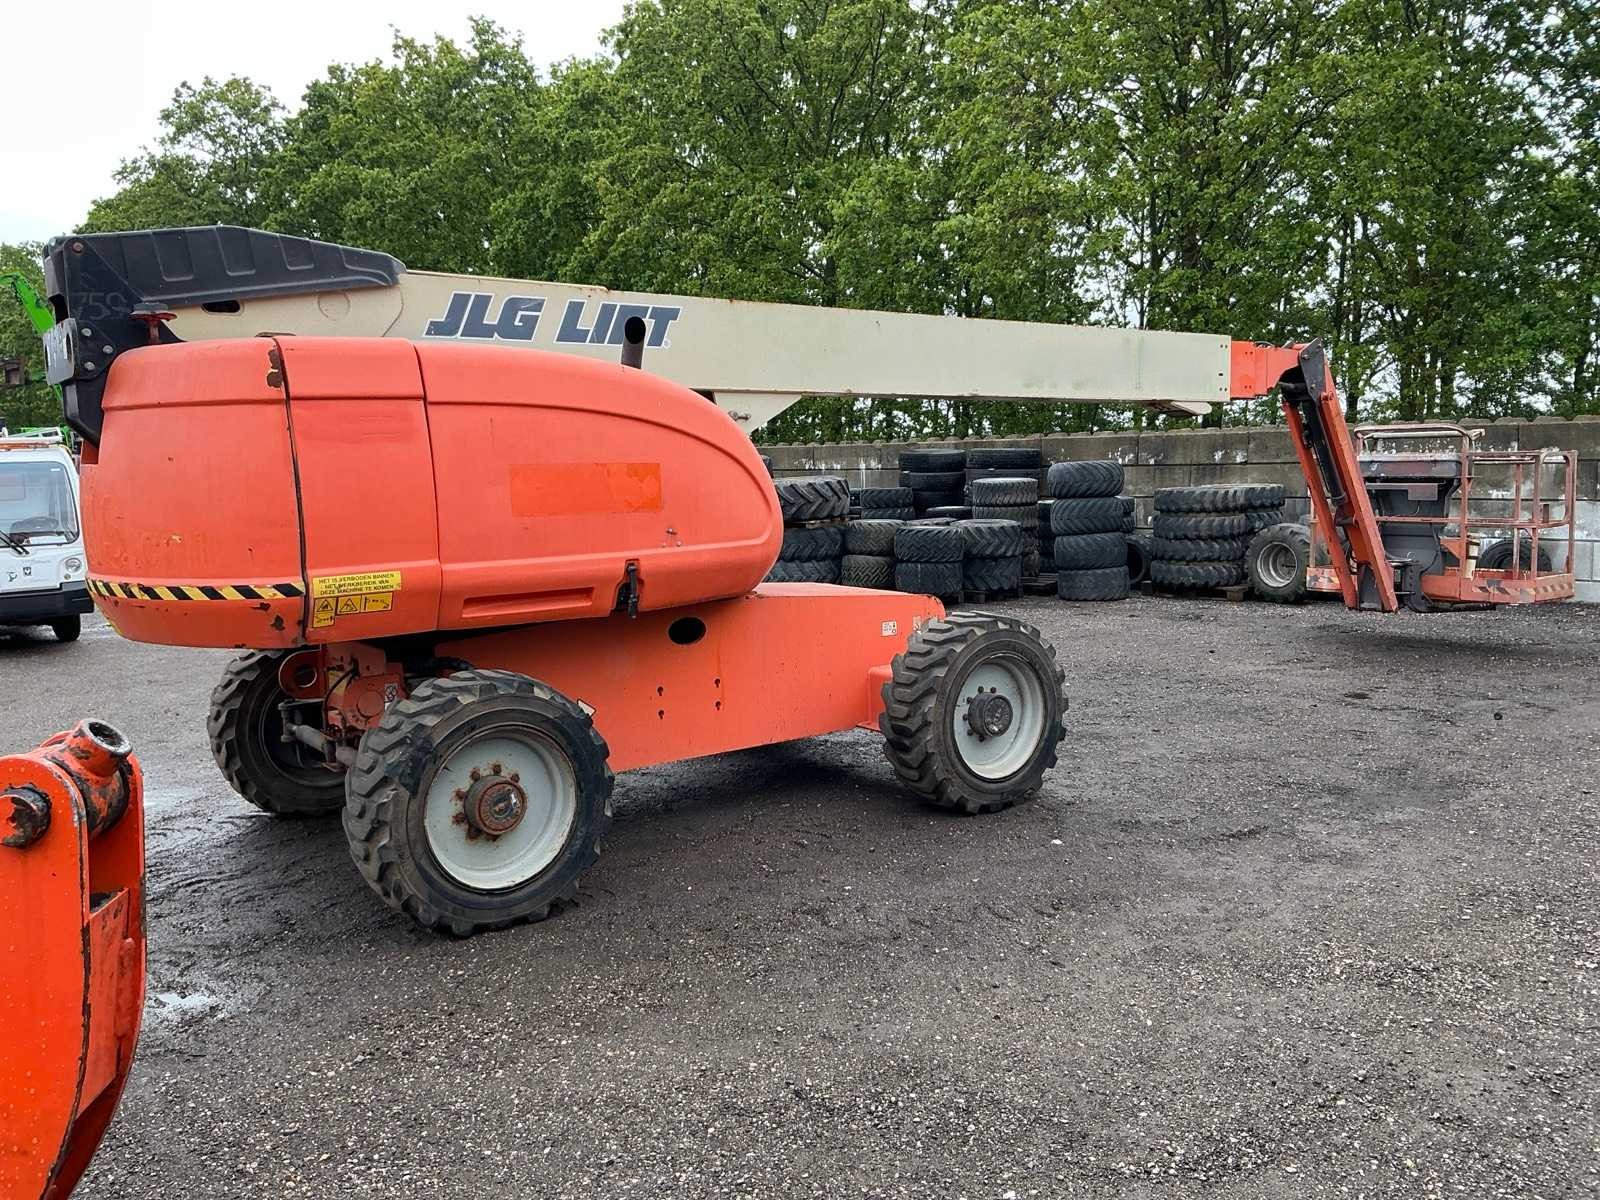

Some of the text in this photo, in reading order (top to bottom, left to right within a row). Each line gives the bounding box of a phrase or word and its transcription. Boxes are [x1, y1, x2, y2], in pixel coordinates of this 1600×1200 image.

[423, 291, 683, 348] JLG LIFT
[338, 575, 372, 584] VERBODEN
